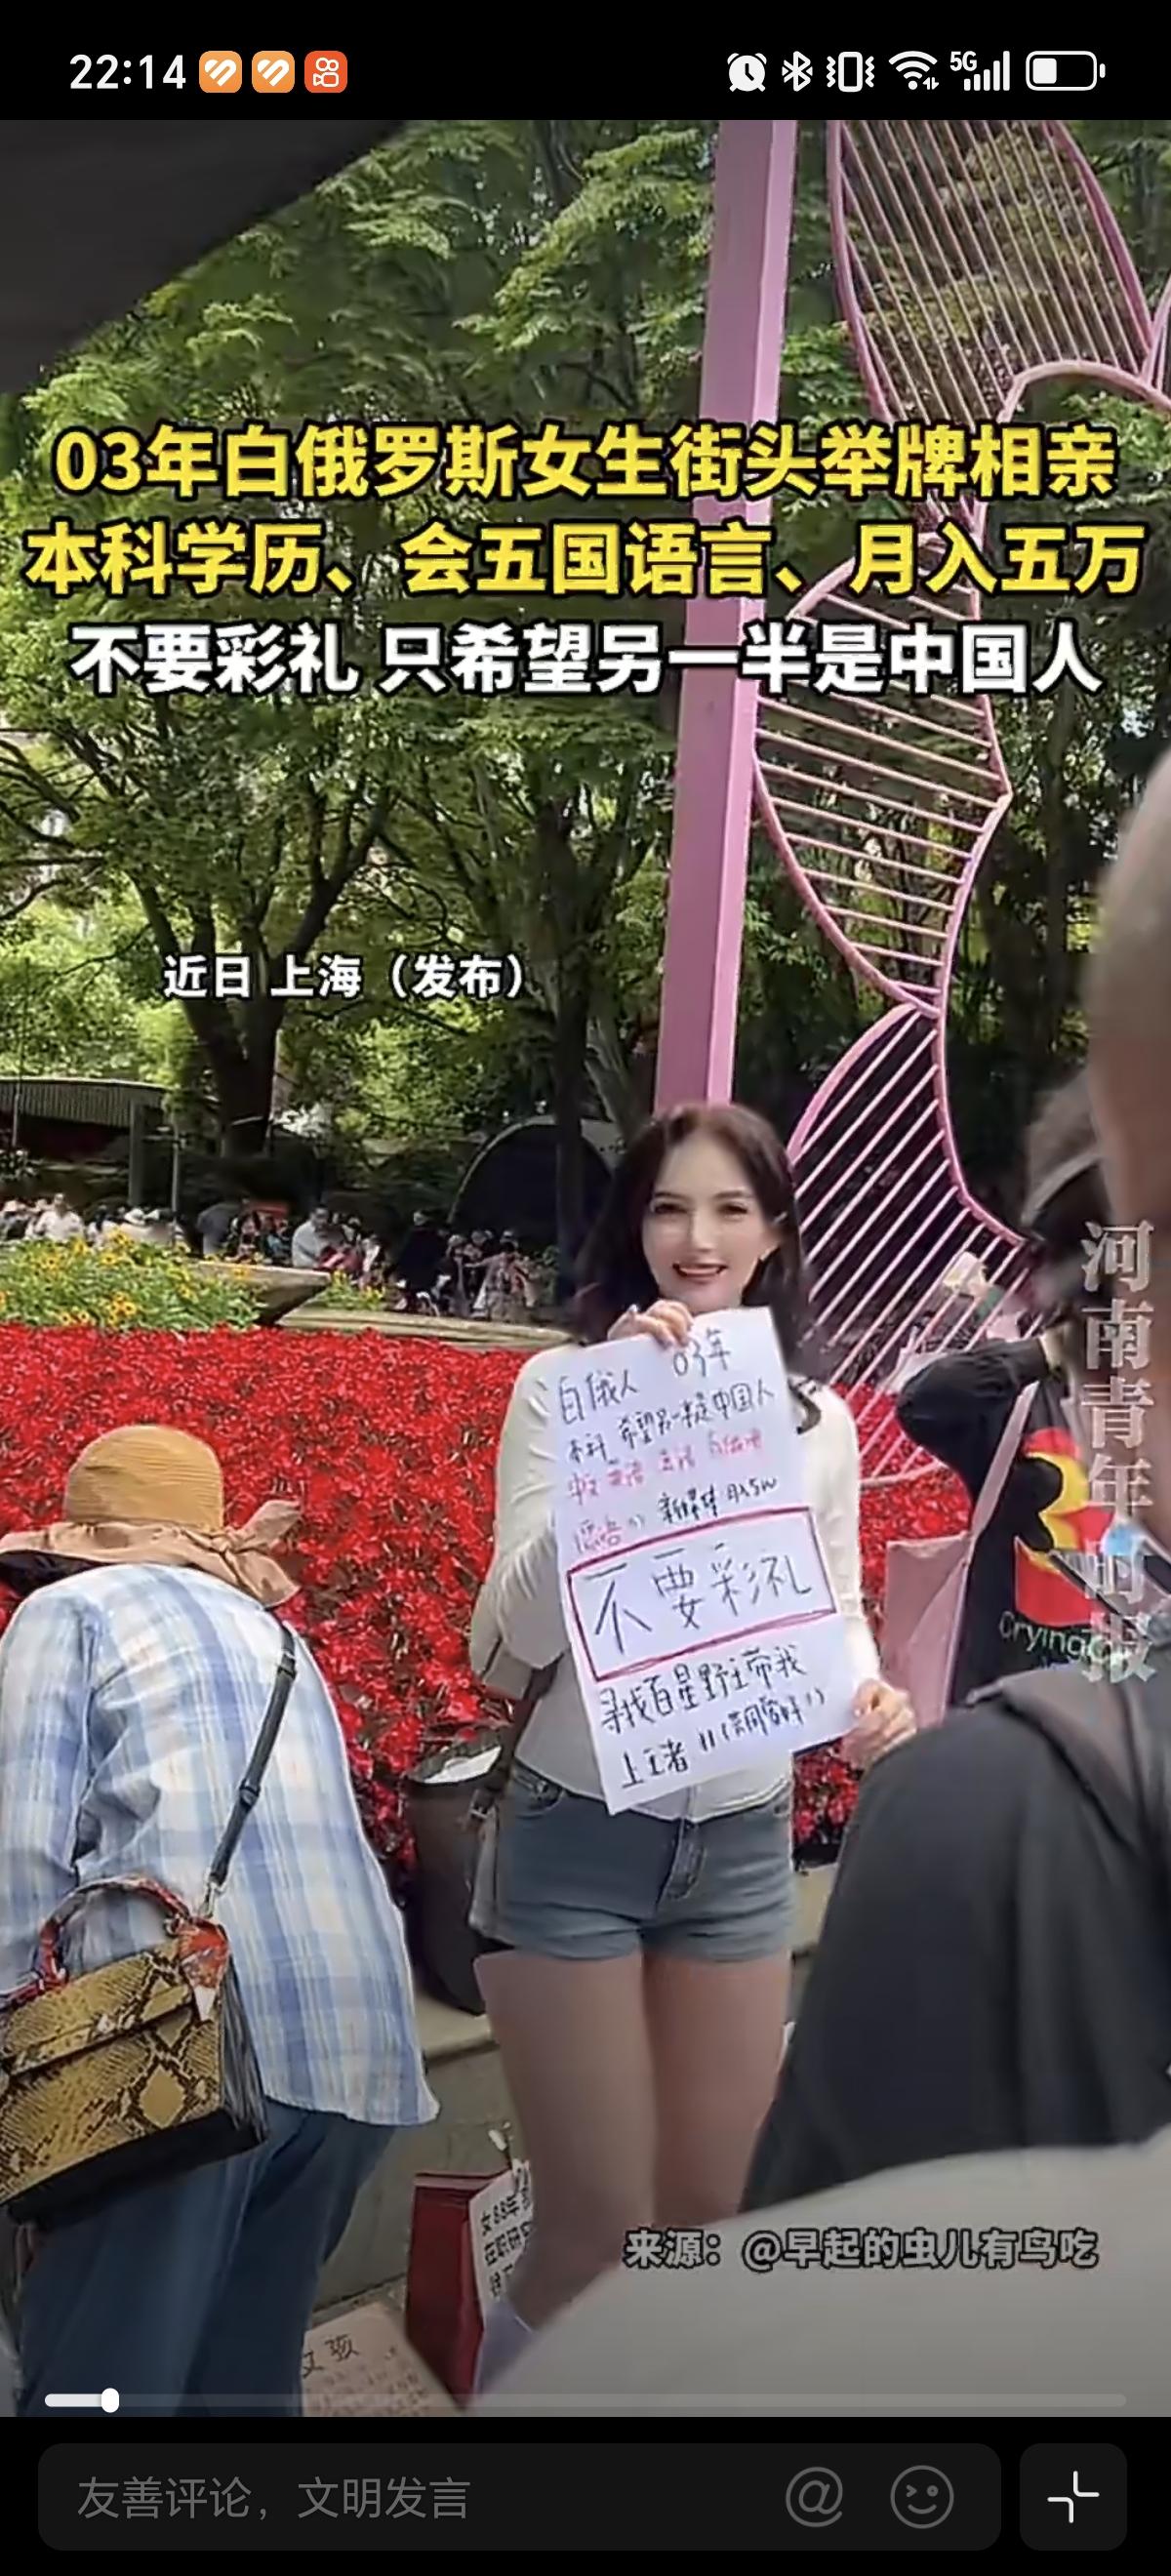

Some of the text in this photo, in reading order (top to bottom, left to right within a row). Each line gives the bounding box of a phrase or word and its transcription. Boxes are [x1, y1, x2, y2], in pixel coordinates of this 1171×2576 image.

[672, 1328, 731, 1378] 03年
[587, 1543, 812, 1654] 不要彩礼
